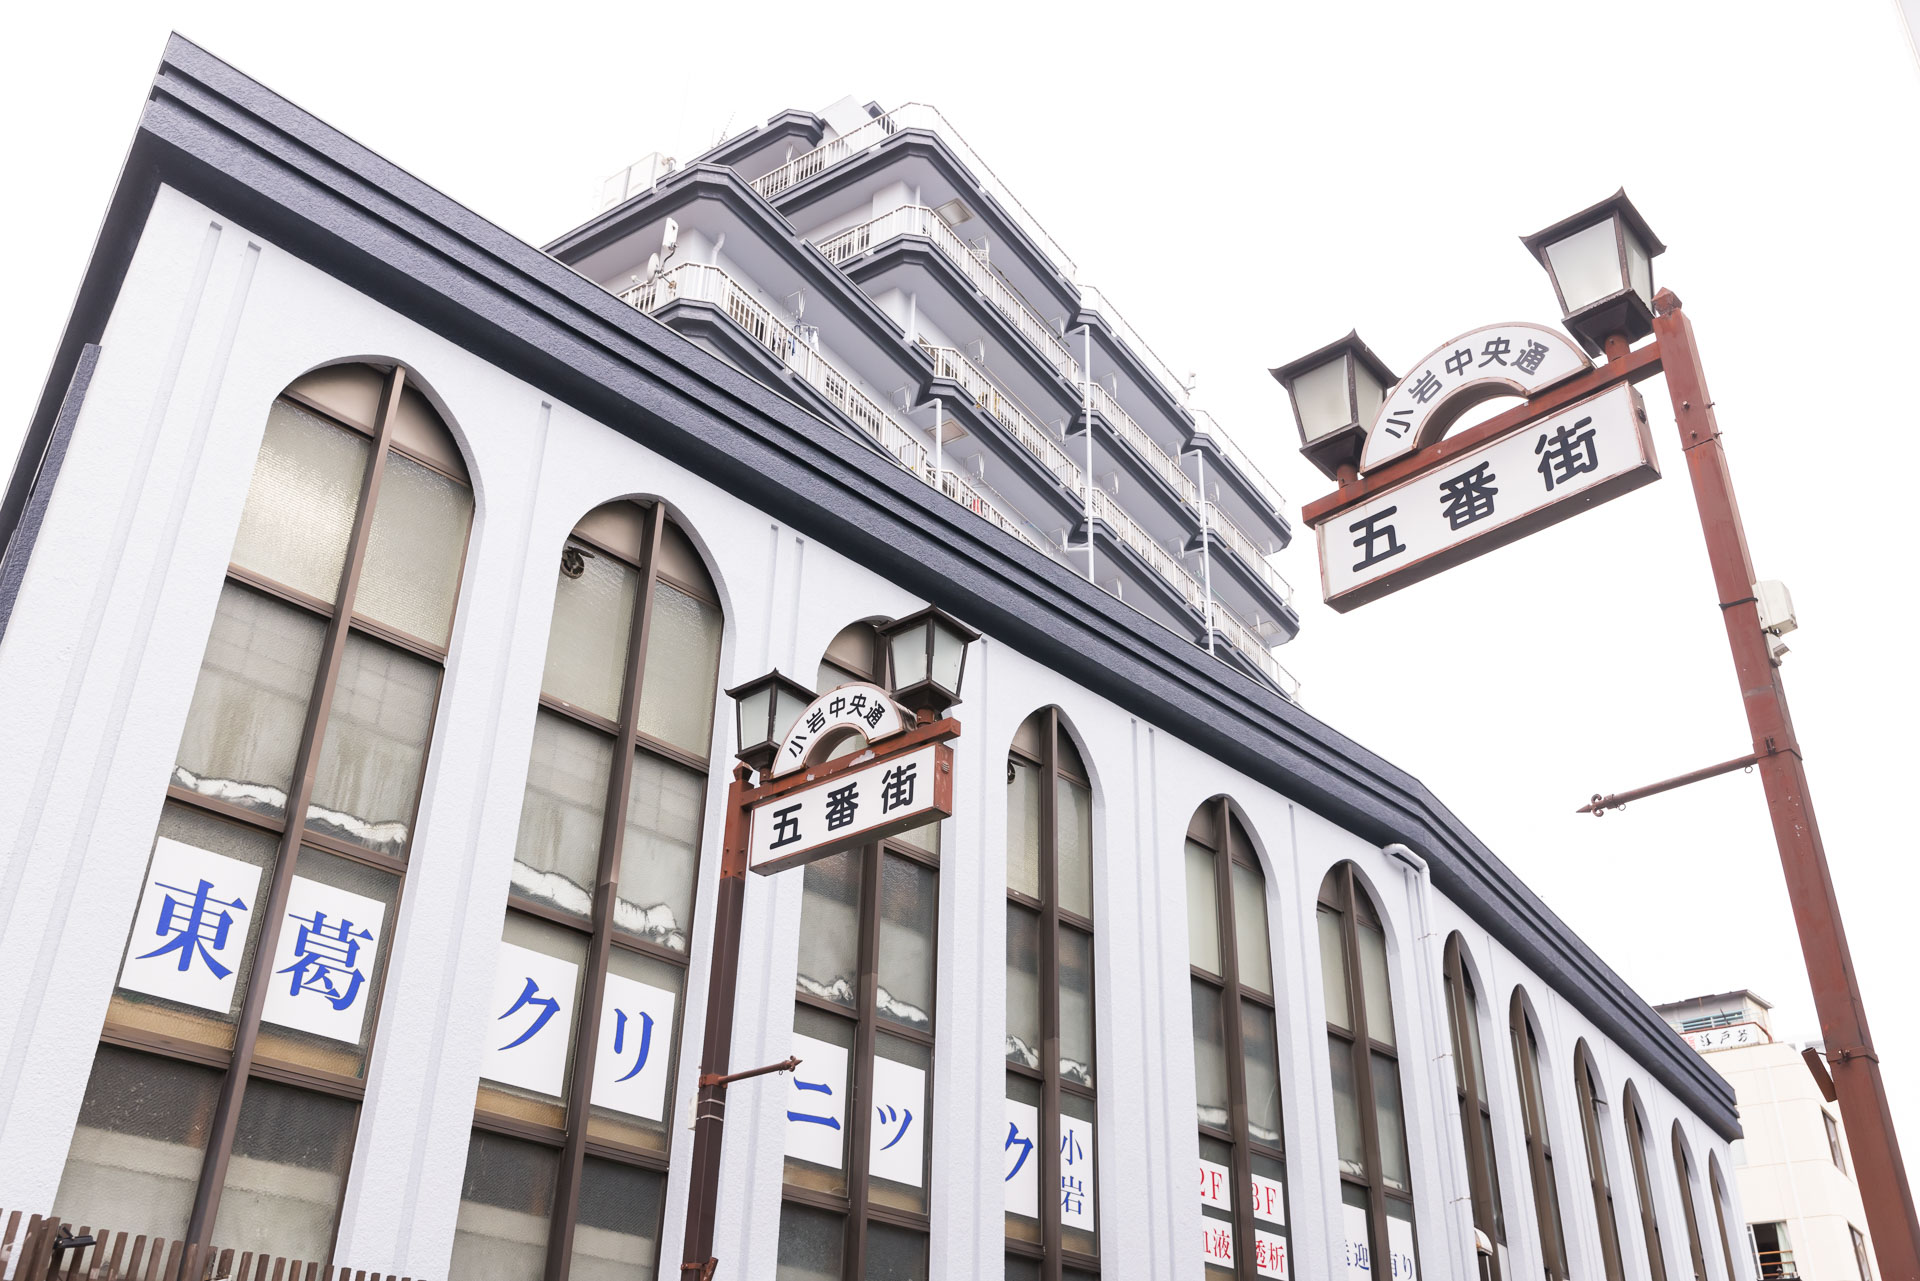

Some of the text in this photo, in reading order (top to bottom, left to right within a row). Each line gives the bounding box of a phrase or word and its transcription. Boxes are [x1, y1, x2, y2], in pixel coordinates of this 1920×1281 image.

[1384, 336, 1550, 439] 小岩中央通
[1348, 416, 1599, 572] 五番街
[788, 693, 886, 758] 小岩中央通
[769, 762, 917, 850] 五番街
[1060, 1129, 1085, 1215] 小岩
